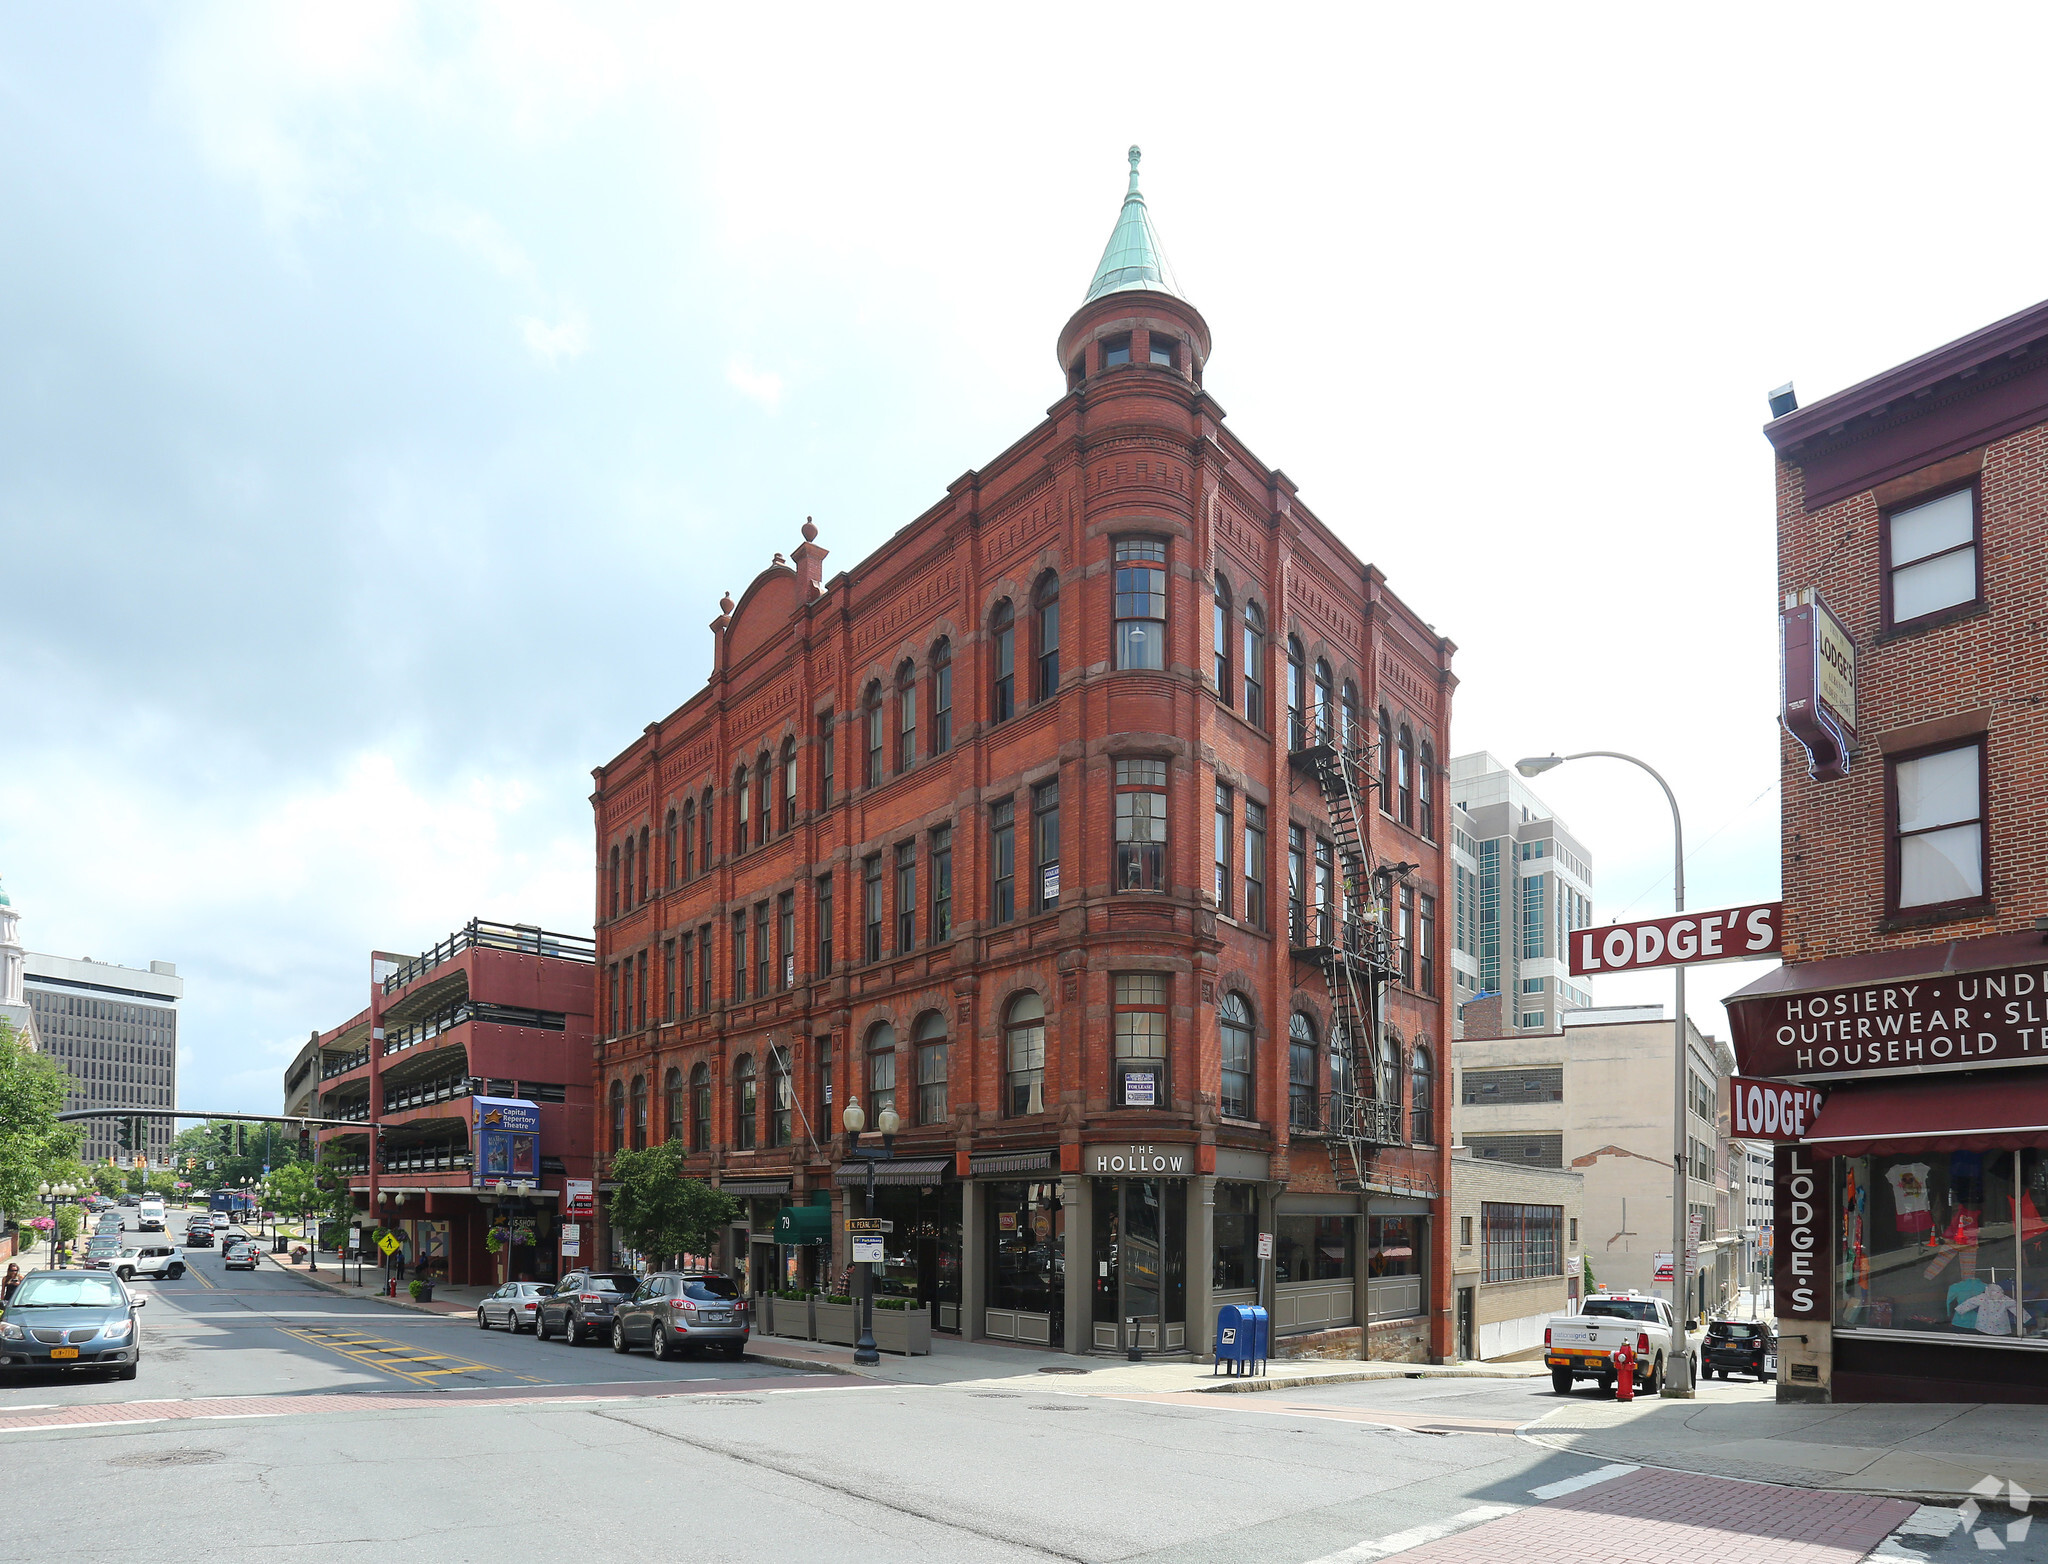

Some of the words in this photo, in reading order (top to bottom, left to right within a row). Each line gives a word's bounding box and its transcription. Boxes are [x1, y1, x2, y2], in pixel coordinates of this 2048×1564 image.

[1819, 629, 1853, 688] LODGE'S
[1582, 908, 1774, 970] LODGE'S
[1786, 985, 1919, 1020] HOSIERY
[1776, 1007, 1971, 1046] OUTERWEAR
[1796, 1032, 1998, 1069] HOUSEHOLD
[503, 1108, 526, 1117] Capital
[503, 1115, 536, 1125] Repertory
[503, 1121, 529, 1129] Theatre
[1130, 1145, 1154, 1154] THE
[1097, 1155, 1183, 1172] HOLLOW
[782, 1216, 790, 1229] 79
[856, 1221, 871, 1229] PEARL
